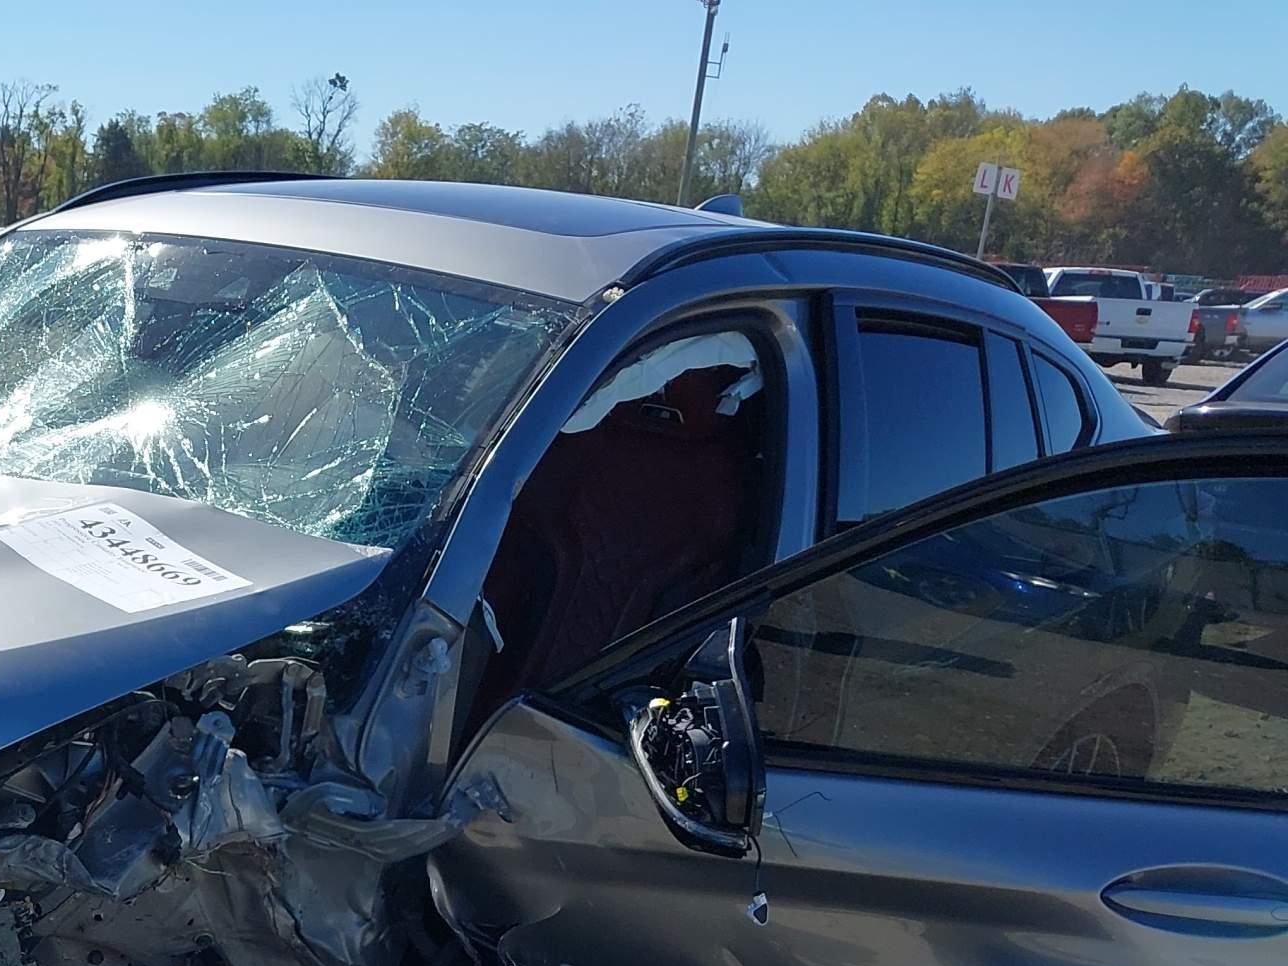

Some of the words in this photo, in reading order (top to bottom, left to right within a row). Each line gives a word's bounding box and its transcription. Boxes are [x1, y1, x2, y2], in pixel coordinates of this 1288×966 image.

[980, 169, 988, 188] L
[1003, 174, 1015, 194] K
[79, 518, 201, 586] 43448669
